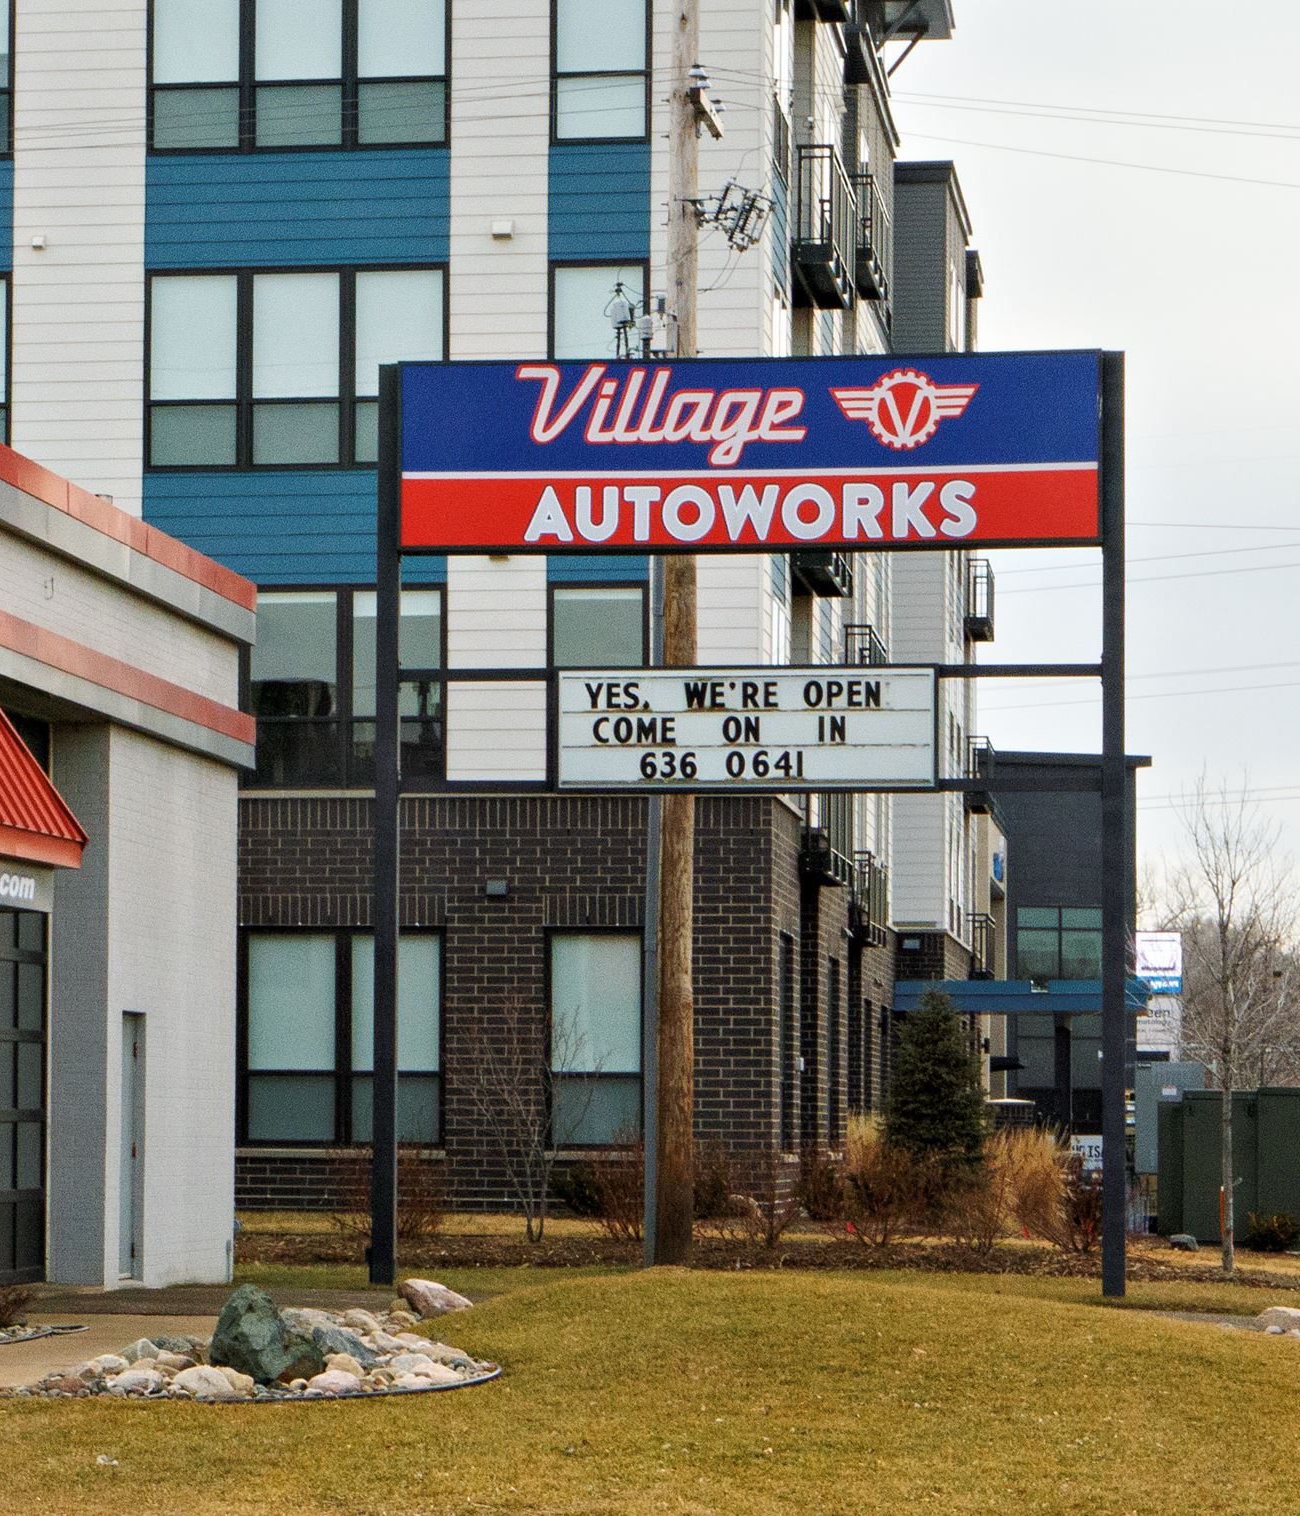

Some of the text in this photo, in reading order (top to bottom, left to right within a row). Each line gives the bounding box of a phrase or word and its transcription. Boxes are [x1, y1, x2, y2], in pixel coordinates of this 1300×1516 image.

[516, 363, 808, 467] Village
[523, 479, 980, 543] AUTOWORKS
[684, 681, 779, 710] WE'RE
[803, 680, 882, 708] OPEN
[592, 715, 847, 744] COME ON IN
[639, 750, 804, 779] 636 0641
